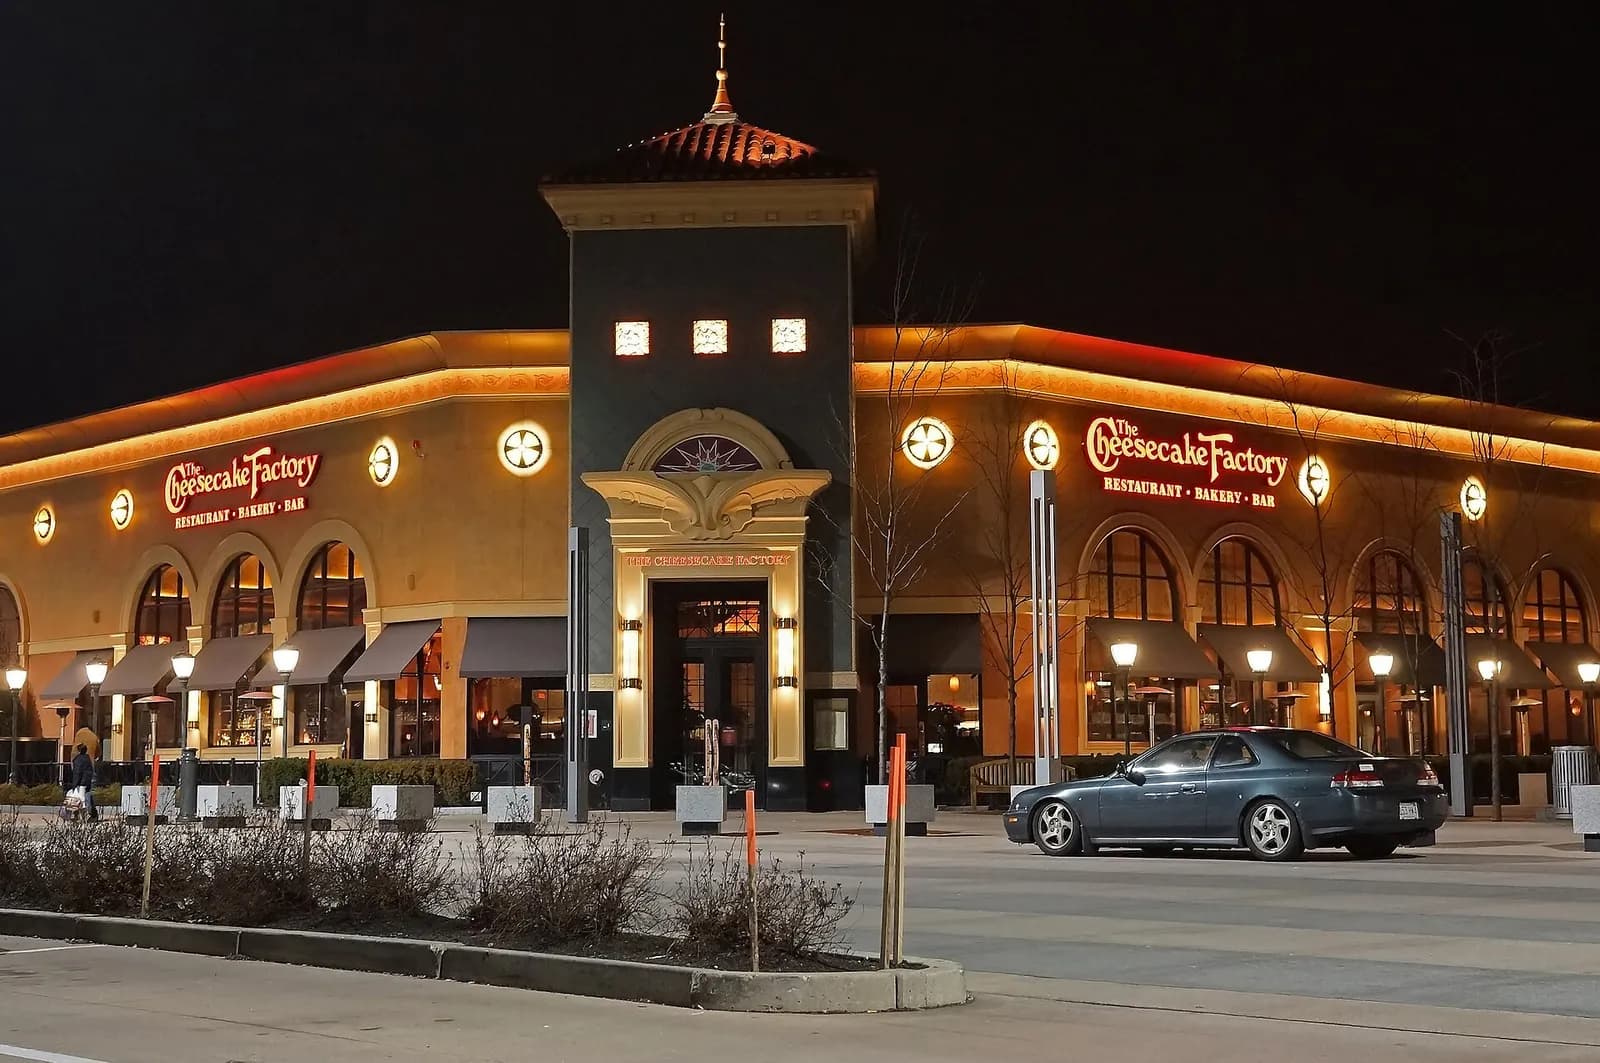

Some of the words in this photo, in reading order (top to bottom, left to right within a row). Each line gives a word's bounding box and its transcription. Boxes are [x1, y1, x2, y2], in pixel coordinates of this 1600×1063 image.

[1116, 419, 1138, 437] The
[1086, 416, 1209, 472] Cheesecake
[1197, 432, 1288, 487] Factory
[165, 458, 250, 514] Cheesecake
[243, 446, 319, 500] Factory
[185, 462, 201, 476] The
[1103, 476, 1183, 498] RESTAURANT
[1194, 487, 1242, 504] BAKERY
[1252, 493, 1275, 508] BAR
[175, 509, 230, 529] RESTAURANT
[238, 501, 277, 519] BAKERY
[284, 497, 305, 512] BAR
[626, 555, 651, 567] THE
[654, 555, 733, 566] CHEESECAKE
[735, 554, 792, 566] FACTORY
